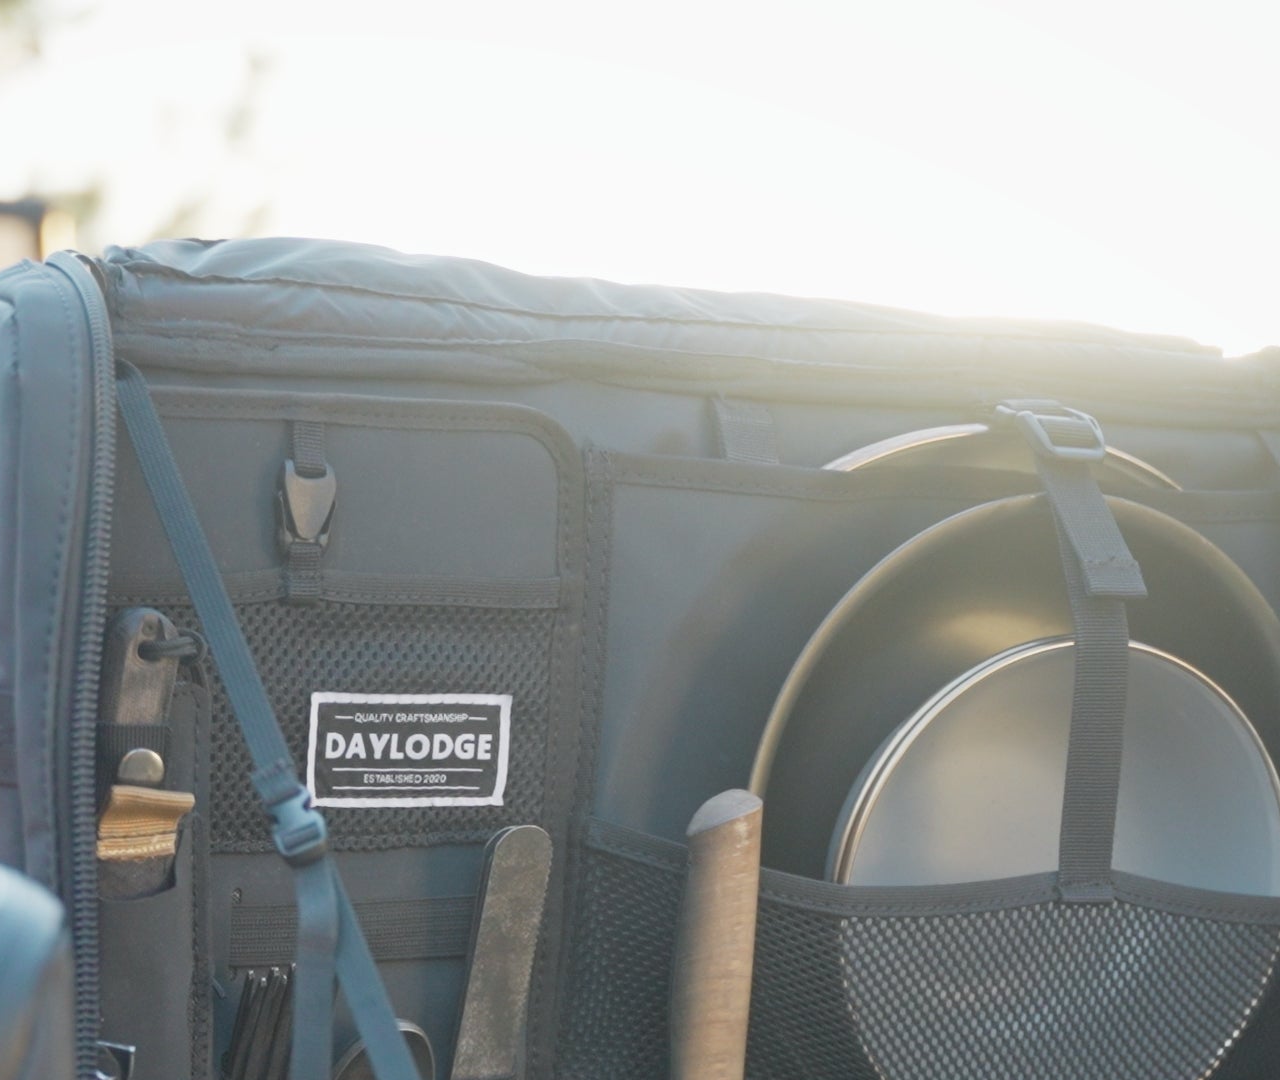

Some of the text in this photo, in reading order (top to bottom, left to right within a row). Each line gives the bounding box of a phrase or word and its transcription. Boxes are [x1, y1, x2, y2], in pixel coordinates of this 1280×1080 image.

[354, 712, 469, 724] QUALITY CRAFTSMANSHIP
[324, 731, 493, 761] DAYLODGE
[363, 773, 447, 784] ESTABLISHED 2020
